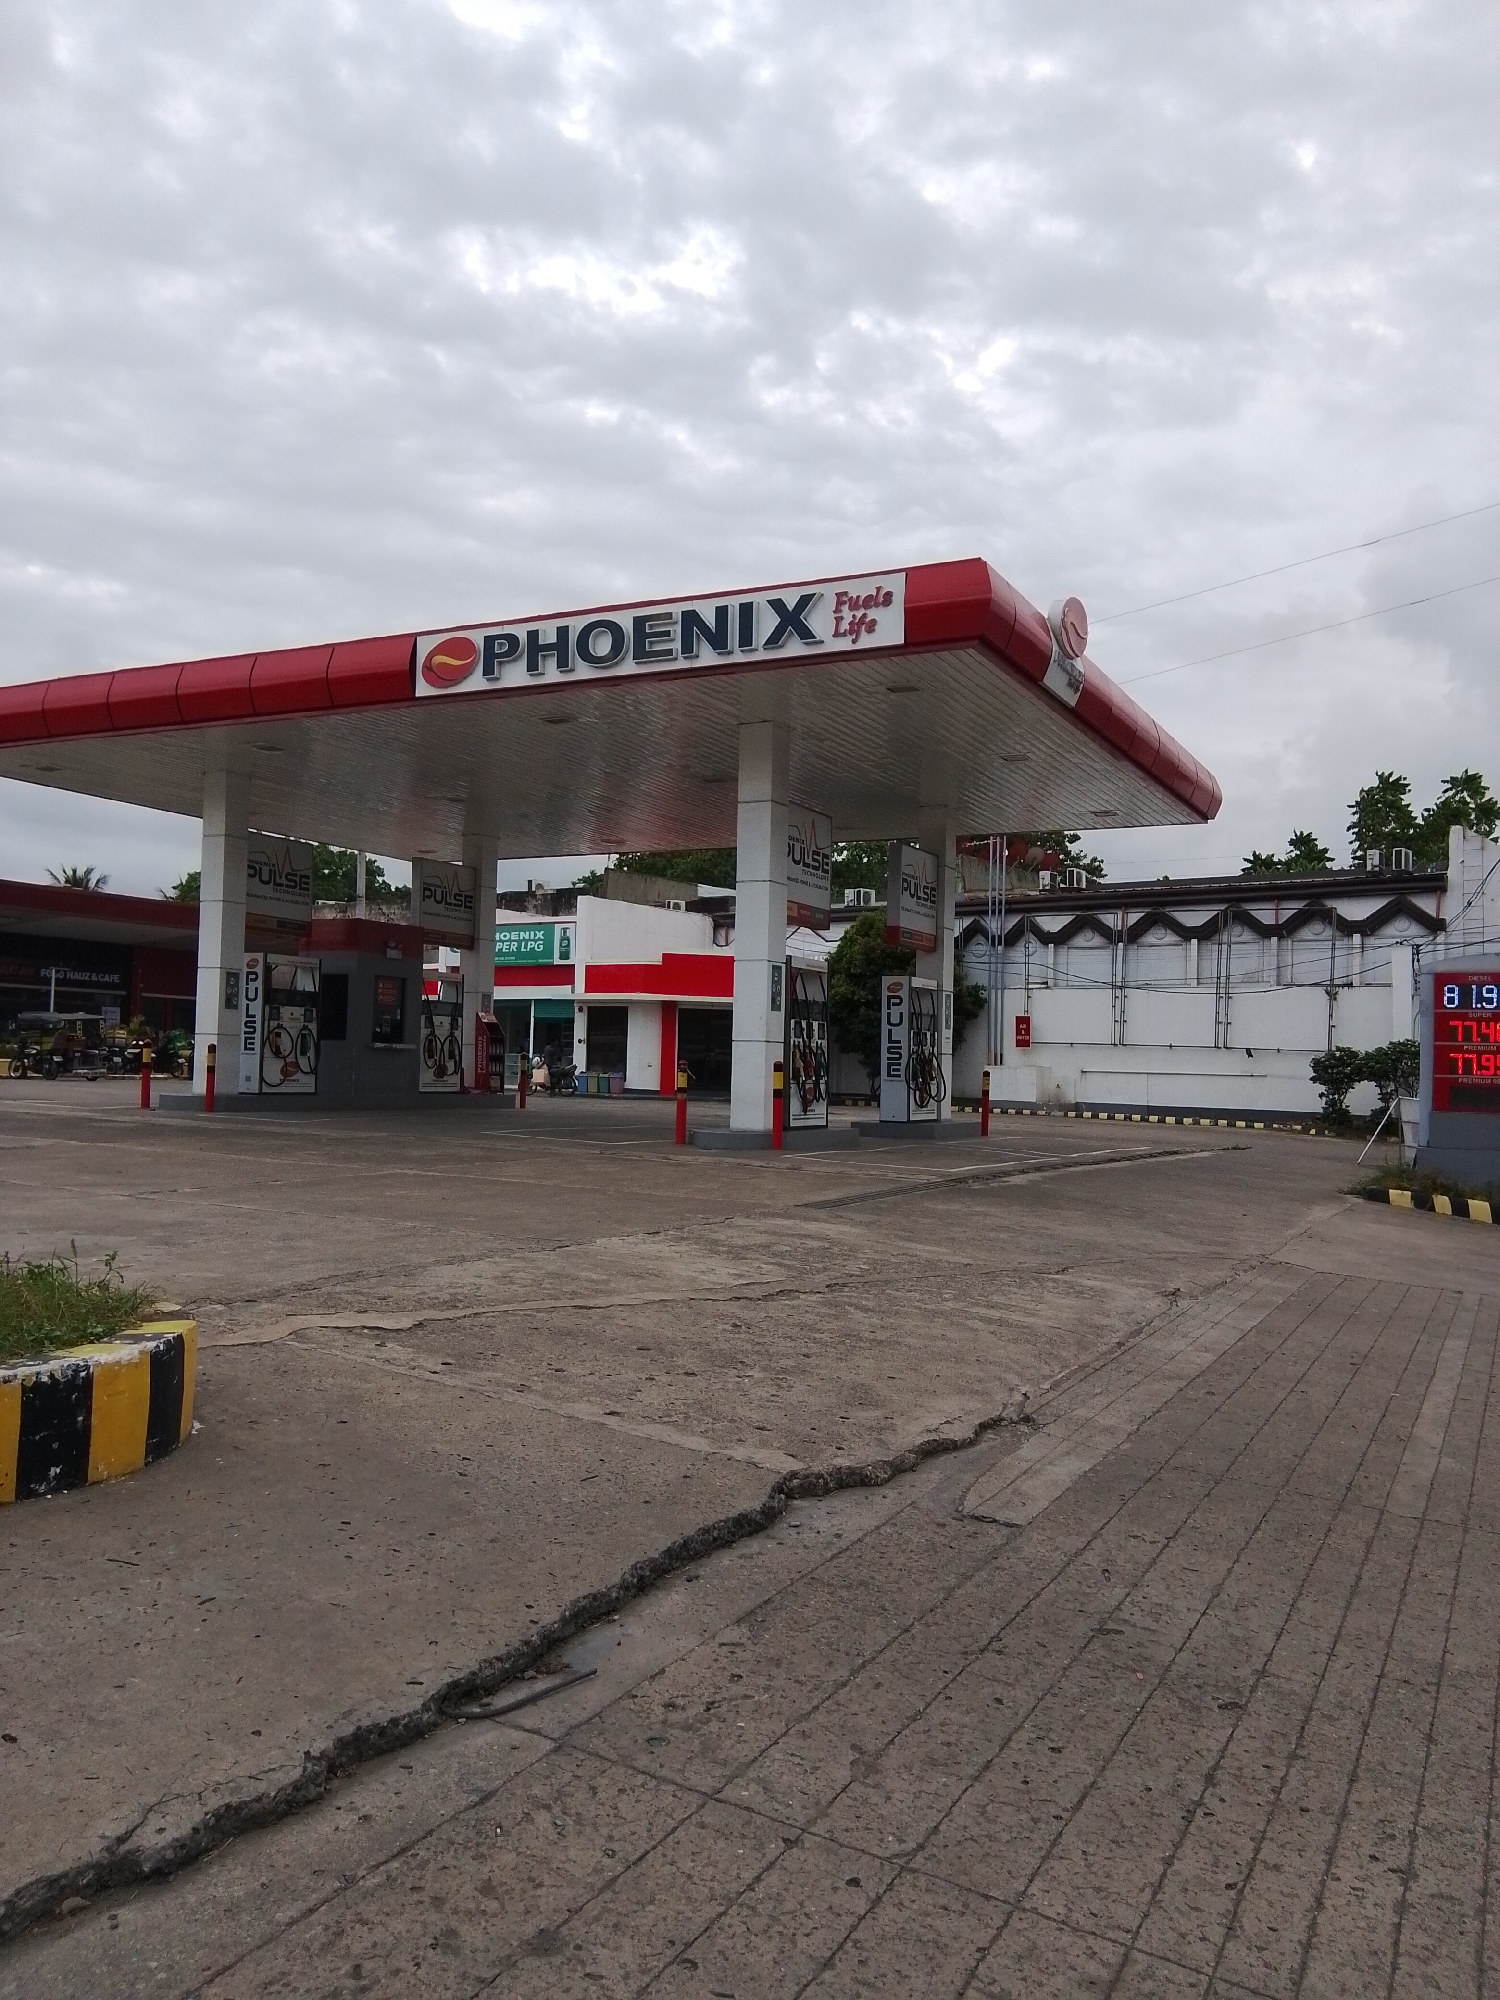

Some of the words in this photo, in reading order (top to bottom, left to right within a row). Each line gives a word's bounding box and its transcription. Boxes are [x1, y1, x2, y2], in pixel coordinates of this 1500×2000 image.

[832, 585, 894, 614] Fuels
[482, 591, 824, 681] PHOENIX
[832, 612, 879, 644] Life
[788, 835, 805, 845] OENIX
[247, 859, 276, 868] HOENIX
[273, 887, 310, 898] TECHNOLOGY
[422, 887, 473, 910] PULSE
[902, 877, 936, 904] PULSE
[495, 931, 544, 940] OENIX
[495, 941, 518, 952] PER
[521, 941, 544, 952] LPG
[66, 971, 90, 981] HAUZ
[91, 972, 97, 981] &
[98, 973, 120, 983] CAFE
[244, 971, 259, 1051] PULSE
[886, 995, 904, 1078] PULSE
[1449, 1021, 1500, 1043] 77.4
[1449, 1053, 1500, 1076] 77.9
